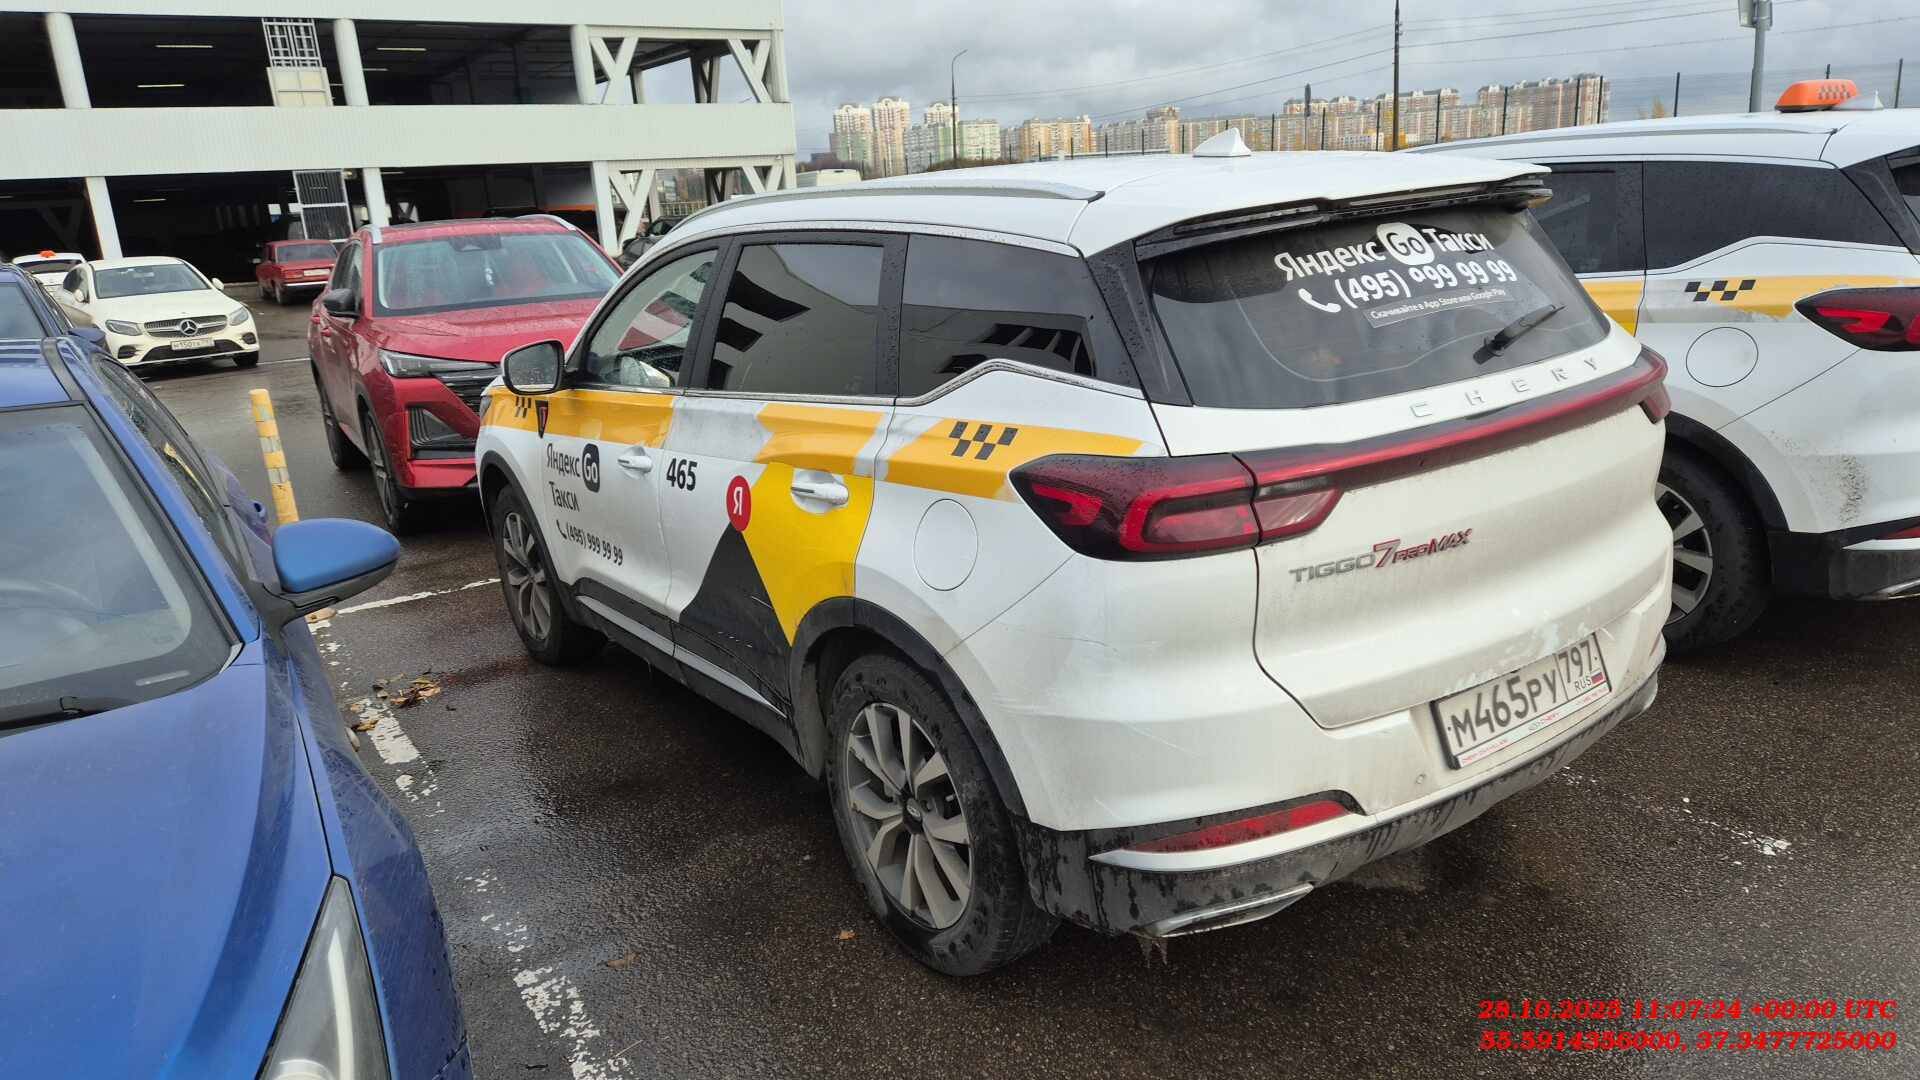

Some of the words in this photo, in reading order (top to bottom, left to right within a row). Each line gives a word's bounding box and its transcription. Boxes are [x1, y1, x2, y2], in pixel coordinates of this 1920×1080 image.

[1274, 241, 1387, 281] Яндекс
[1421, 227, 1495, 252] Такси
[1334, 269, 1412, 309] (495)
[1455, 260, 1489, 285] 99
[1485, 259, 1518, 282] 99
[1410, 357, 1598, 418] CHERY
[546, 442, 581, 478] Яндекс
[665, 457, 698, 492] 465
[548, 481, 580, 512] Такси
[732, 486, 743, 516] Я
[566, 521, 587, 549] (495)
[587, 532, 601, 554] 999
[602, 540, 612, 560] 99
[613, 545, 623, 566] 99
[1288, 552, 1376, 582] TIGGO
[1558, 639, 1593, 684] 797
[1574, 675, 1592, 693] RUS
